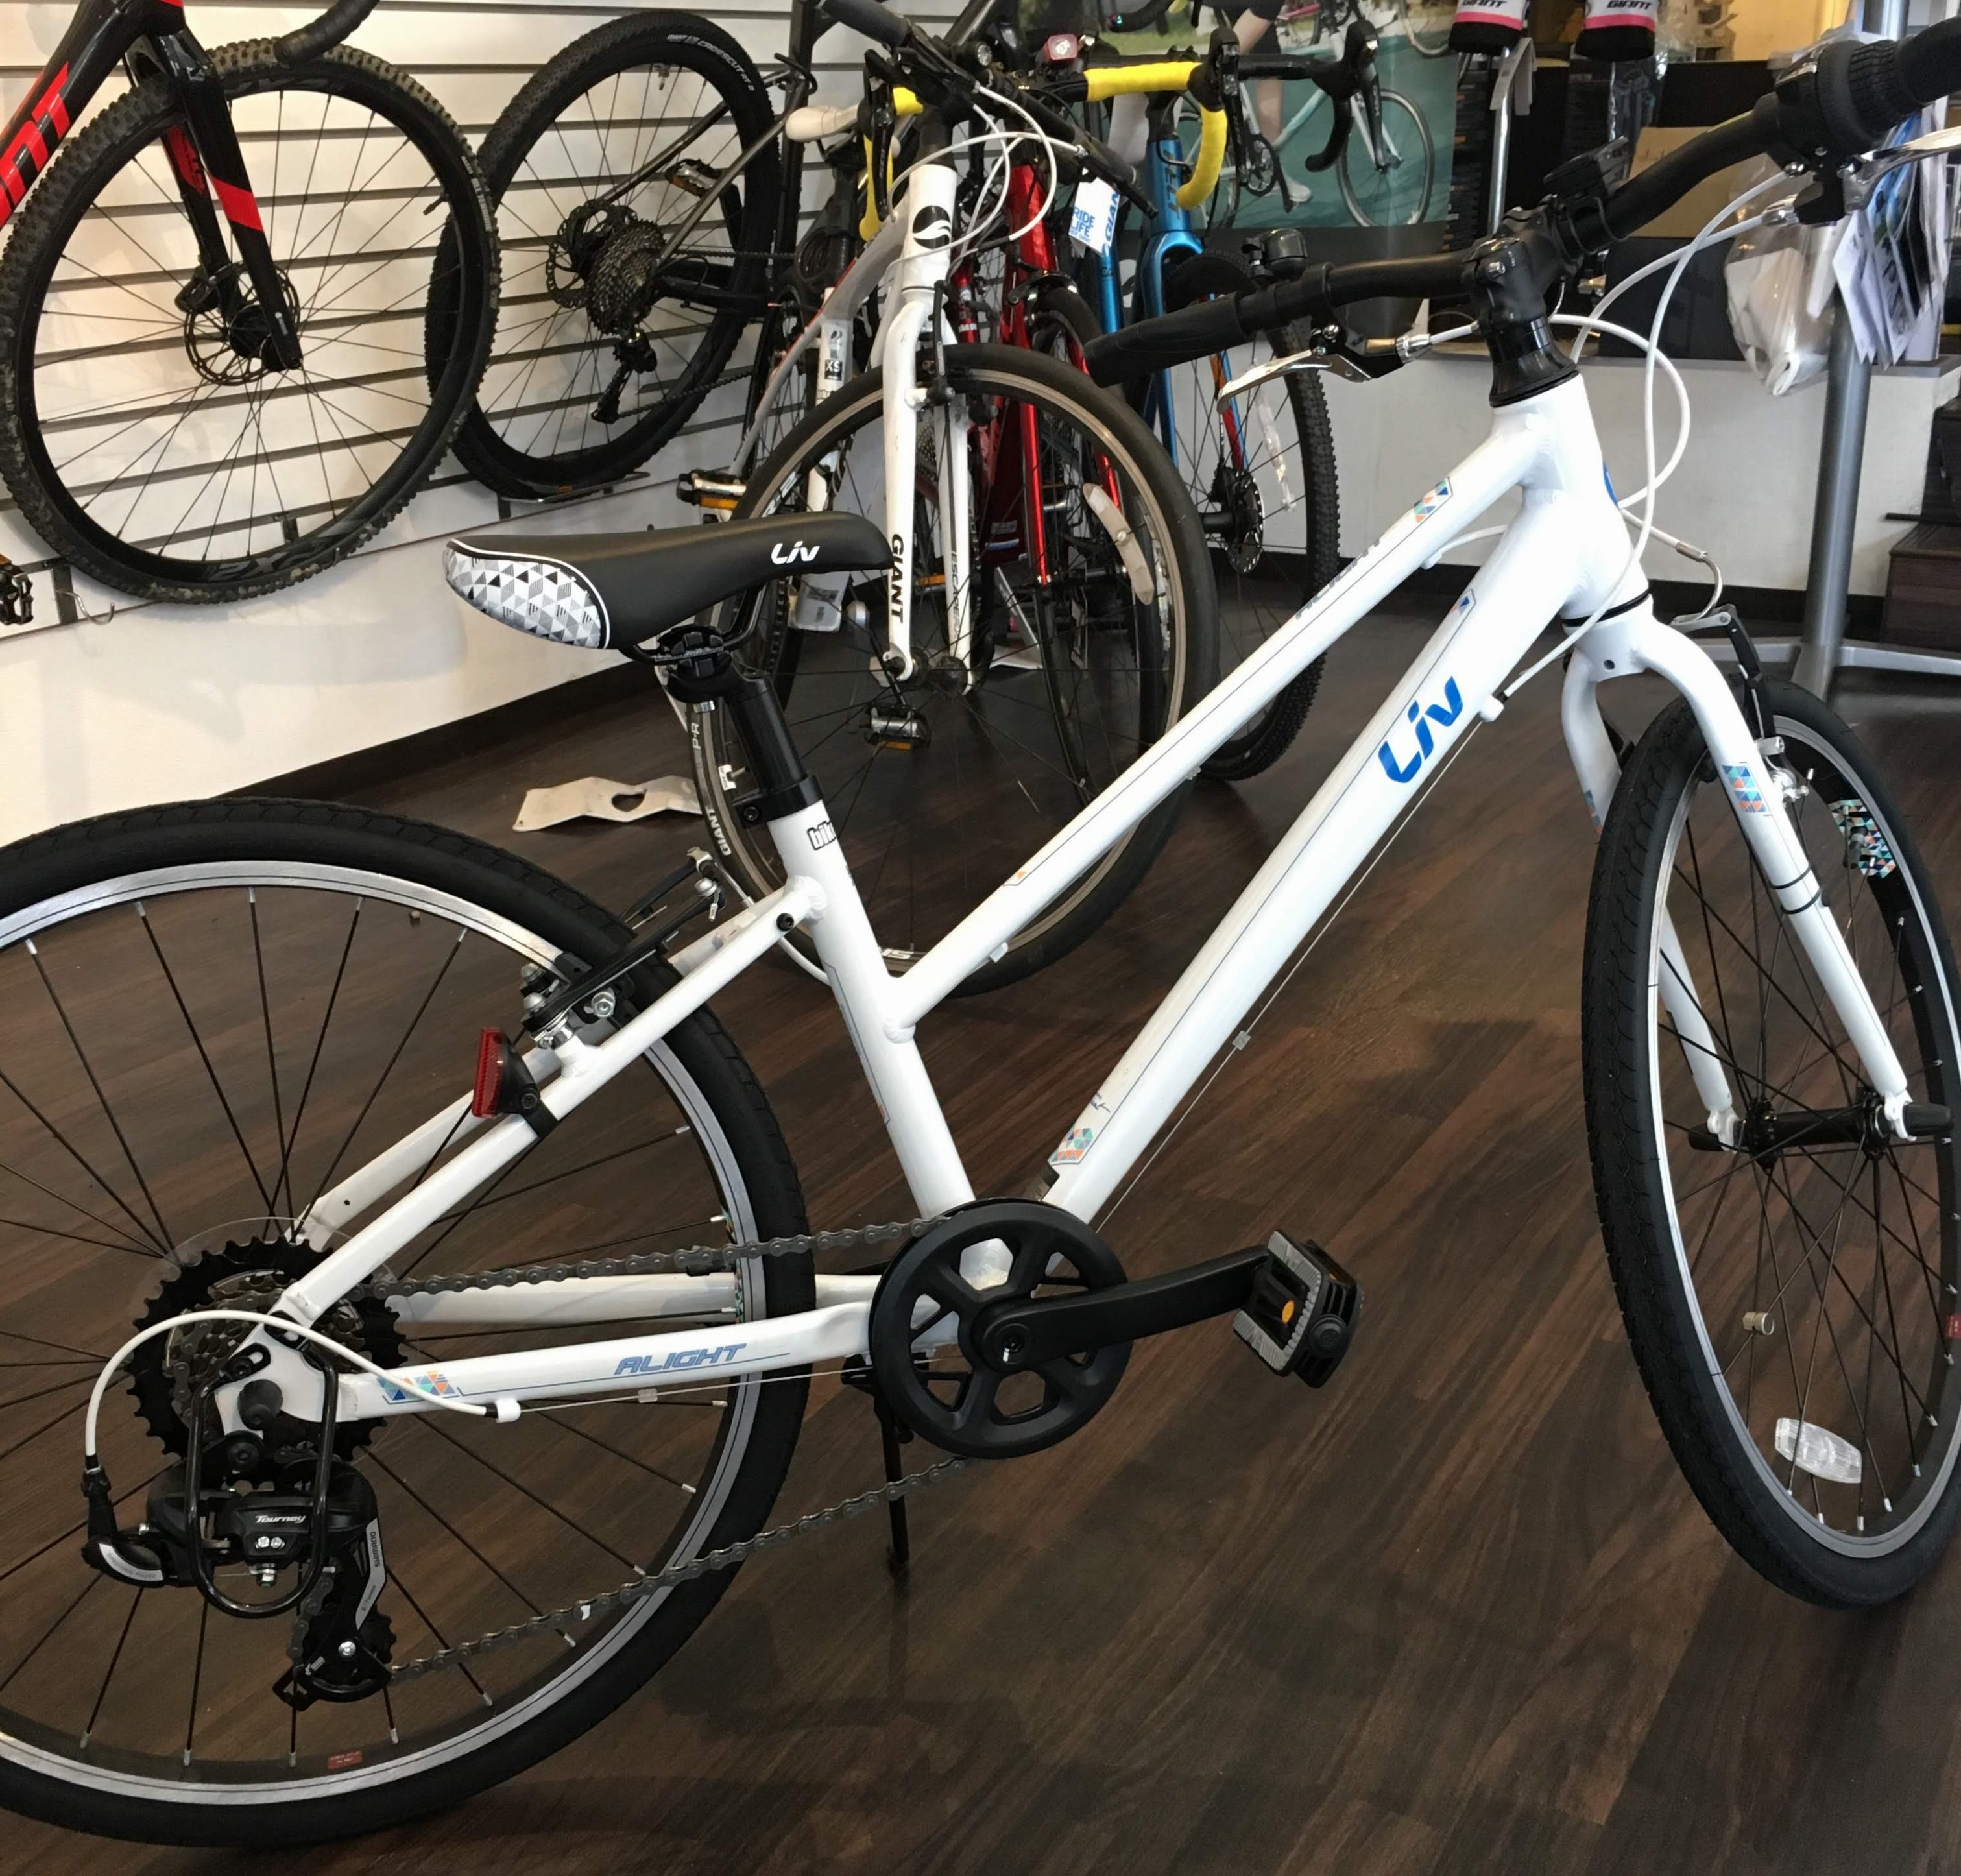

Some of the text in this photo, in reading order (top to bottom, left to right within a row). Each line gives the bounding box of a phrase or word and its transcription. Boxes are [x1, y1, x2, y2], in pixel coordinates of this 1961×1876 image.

[1073, 206, 1096, 228] RIDE
[826, 360, 841, 373] XS
[771, 540, 820, 565] Liv
[891, 533, 904, 625] GIANT
[951, 553, 960, 616] ESCAPE
[1378, 675, 1463, 784] Liv
[704, 805, 732, 856] GIANT
[614, 1342, 747, 1376] ALIGHT
[256, 1515, 306, 1524] Tourney
[369, 1531, 381, 1568] SHIMANO
